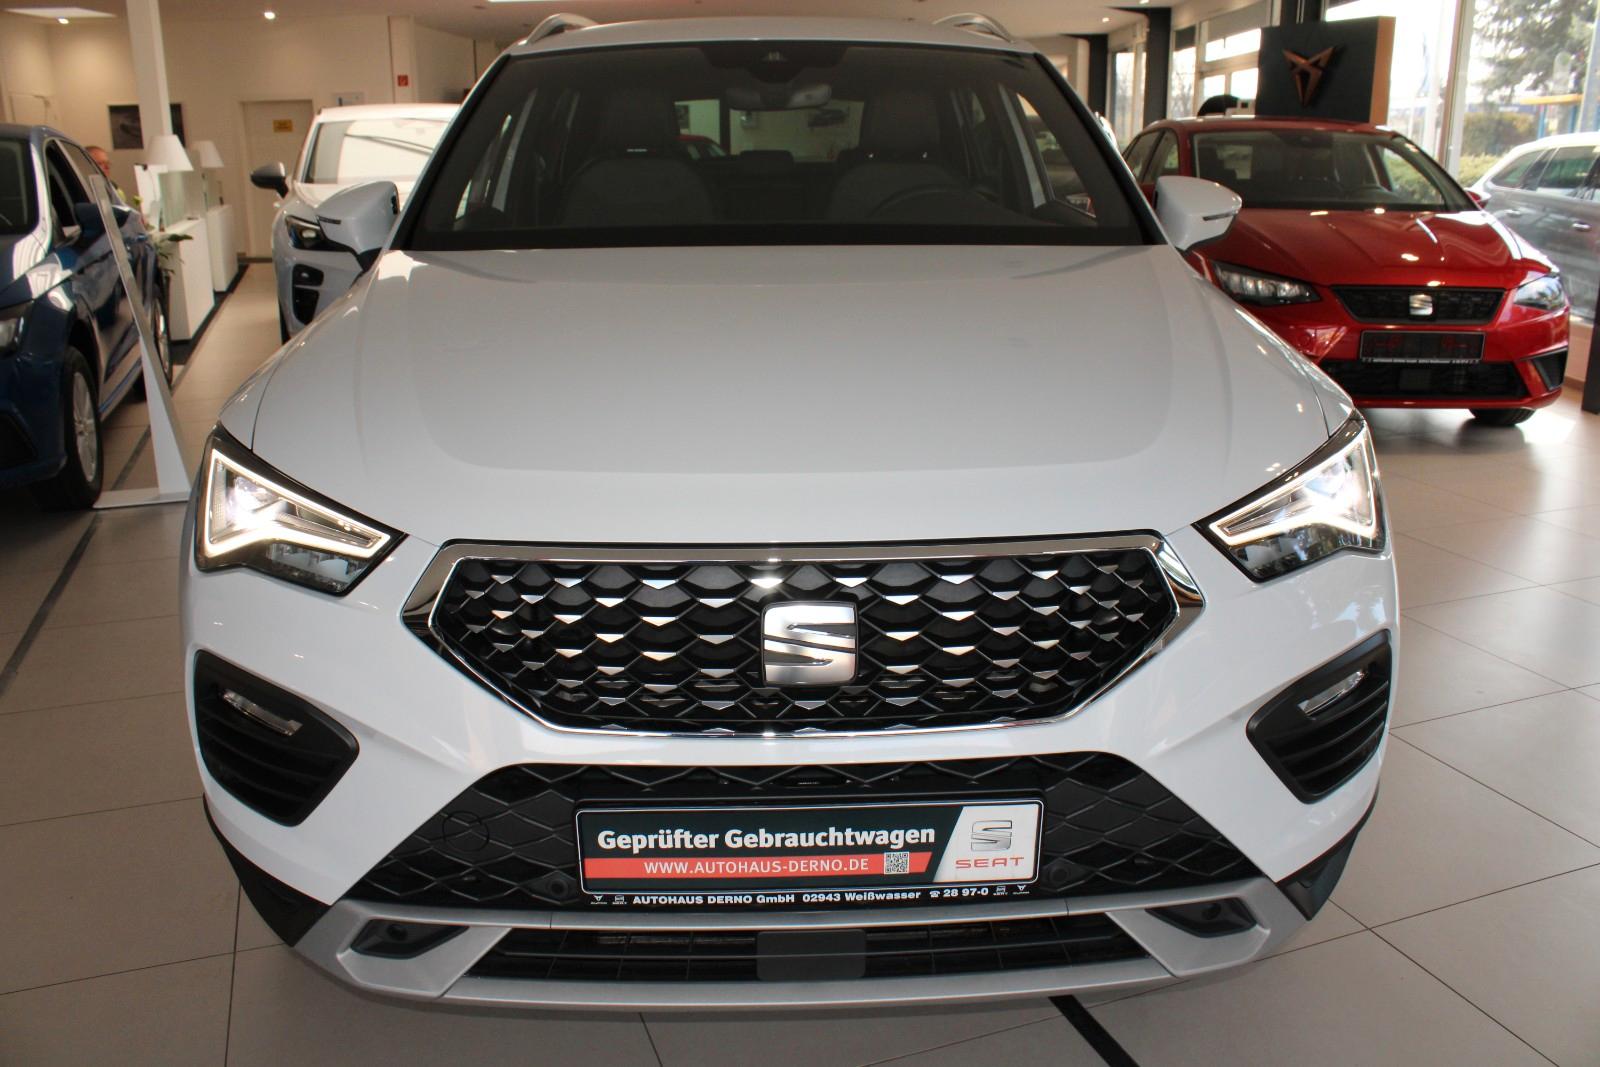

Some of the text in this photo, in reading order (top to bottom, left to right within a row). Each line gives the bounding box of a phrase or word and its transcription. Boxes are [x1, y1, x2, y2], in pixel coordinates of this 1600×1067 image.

[597, 826, 935, 854] Geprüfter Gebrauchtwagen
[644, 858, 869, 874] WWW.AUTOHAUS-DERNO.DE
[955, 856, 1024, 869] SEAT
[632, 895, 704, 905] AUTOHAUS
[707, 894, 752, 904] DERNO
[756, 894, 795, 903] GmbH
[802, 893, 841, 903] 02943
[844, 891, 921, 902] Weißwasser
[943, 889, 959, 898] 28
[962, 887, 989, 897] 97-0
